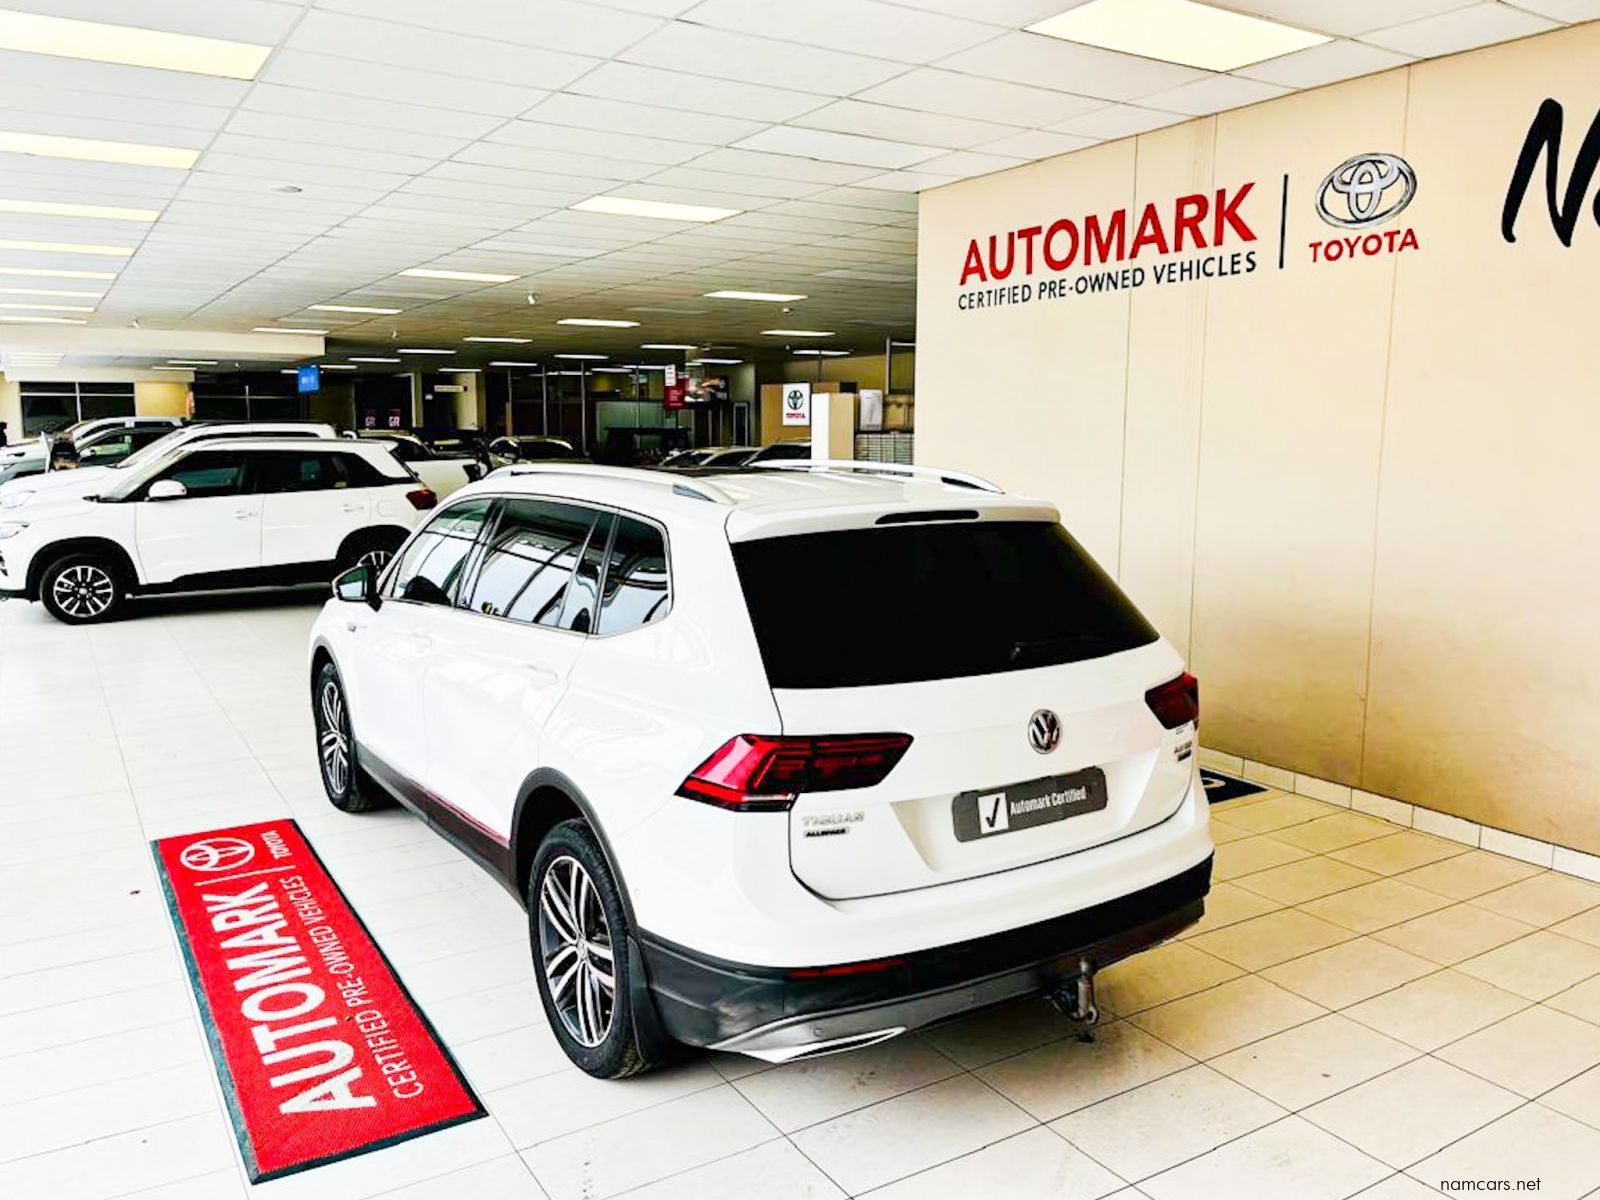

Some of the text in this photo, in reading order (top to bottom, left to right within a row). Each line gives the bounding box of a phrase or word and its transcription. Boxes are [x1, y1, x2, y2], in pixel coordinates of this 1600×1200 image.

[1501, 97, 1600, 248] N
[959, 181, 1258, 286] AUTOMARK
[1309, 228, 1420, 264] TOYOTA
[957, 250, 1257, 311] CERTIFIED PRE-OWNED VEHICLES
[1010, 786, 1087, 817] Automark Certified
[261, 829, 292, 860] TOYOTA
[201, 881, 378, 1116] AUTOMARK
[280, 875, 425, 1099] CERTIFIED PRE-OWNED VEHICLES
